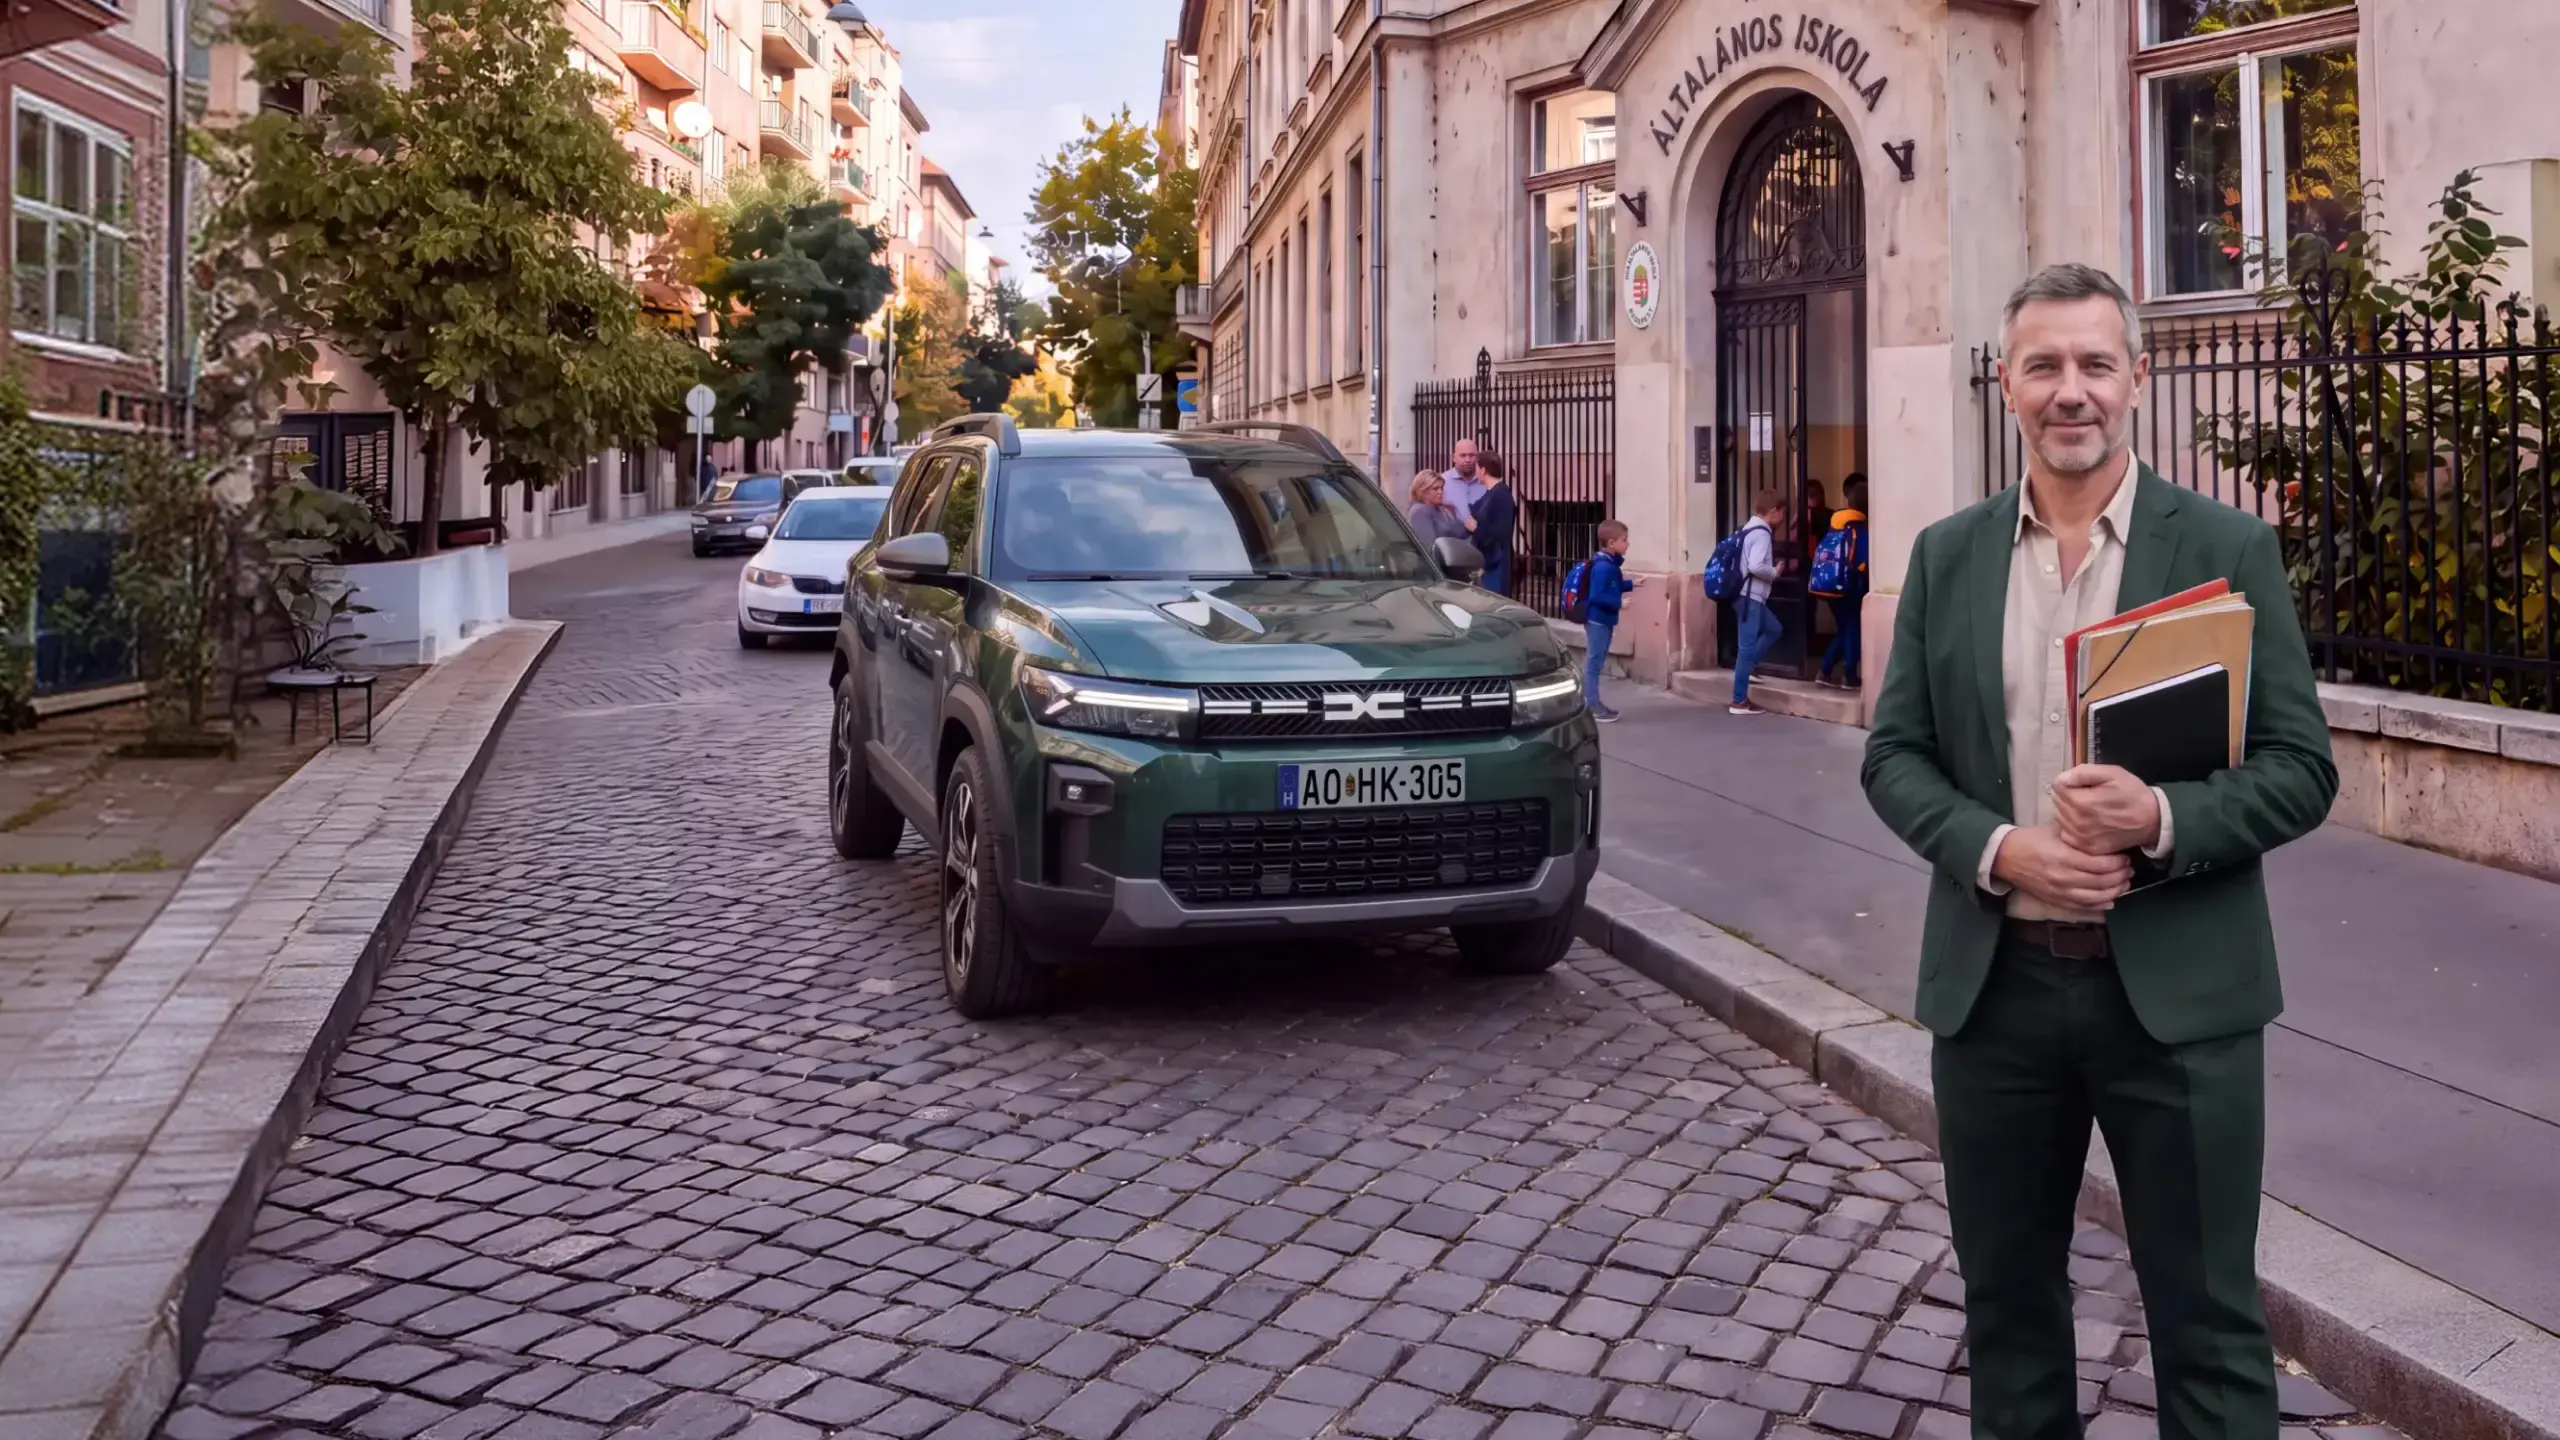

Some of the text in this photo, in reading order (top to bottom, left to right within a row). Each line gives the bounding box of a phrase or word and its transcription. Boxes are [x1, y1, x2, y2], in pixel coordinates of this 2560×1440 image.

[1650, 13, 1889, 156] ÁLTALÁNOS ISKOLA
[1283, 791, 1293, 806] H
[1358, 763, 1462, 803] HK-305
